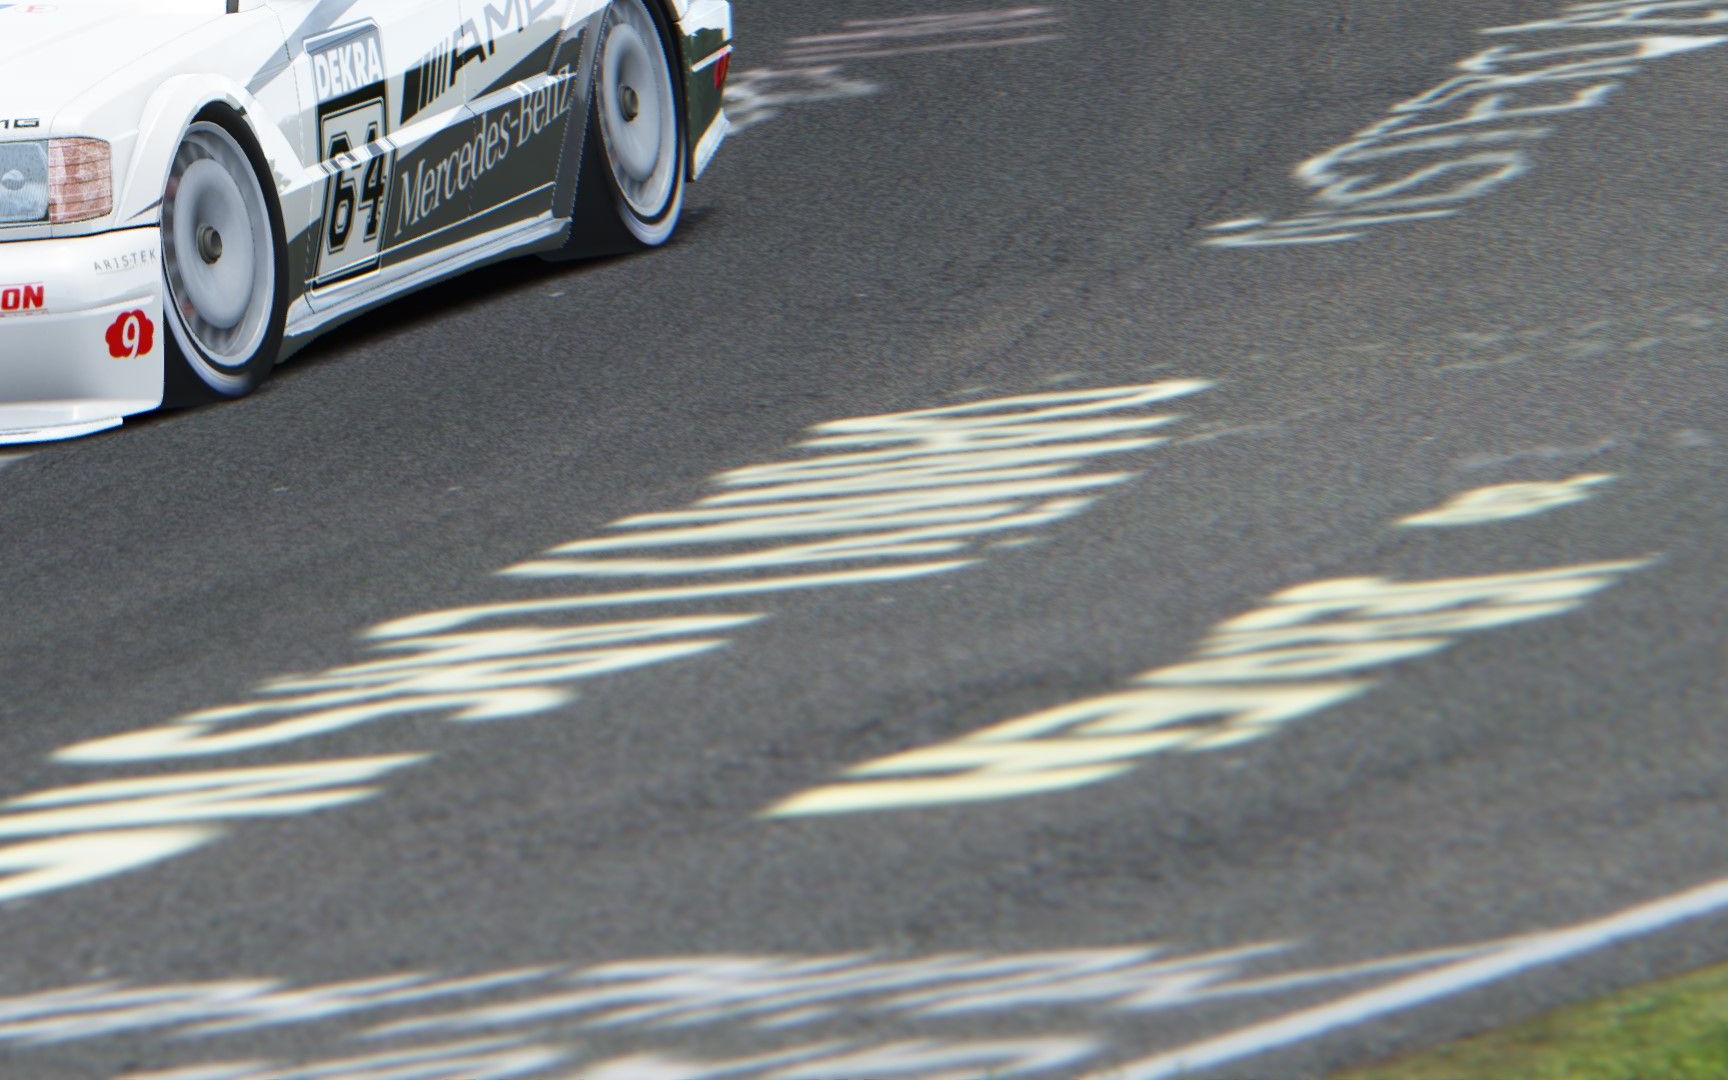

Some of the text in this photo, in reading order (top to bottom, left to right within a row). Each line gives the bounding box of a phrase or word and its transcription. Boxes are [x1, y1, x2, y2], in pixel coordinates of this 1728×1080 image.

[313, 37, 385, 101] DEKRA
[325, 121, 388, 255] 64
[393, 63, 572, 238] Mercedes-Benz
[93, 248, 157, 272] ARISTEK
